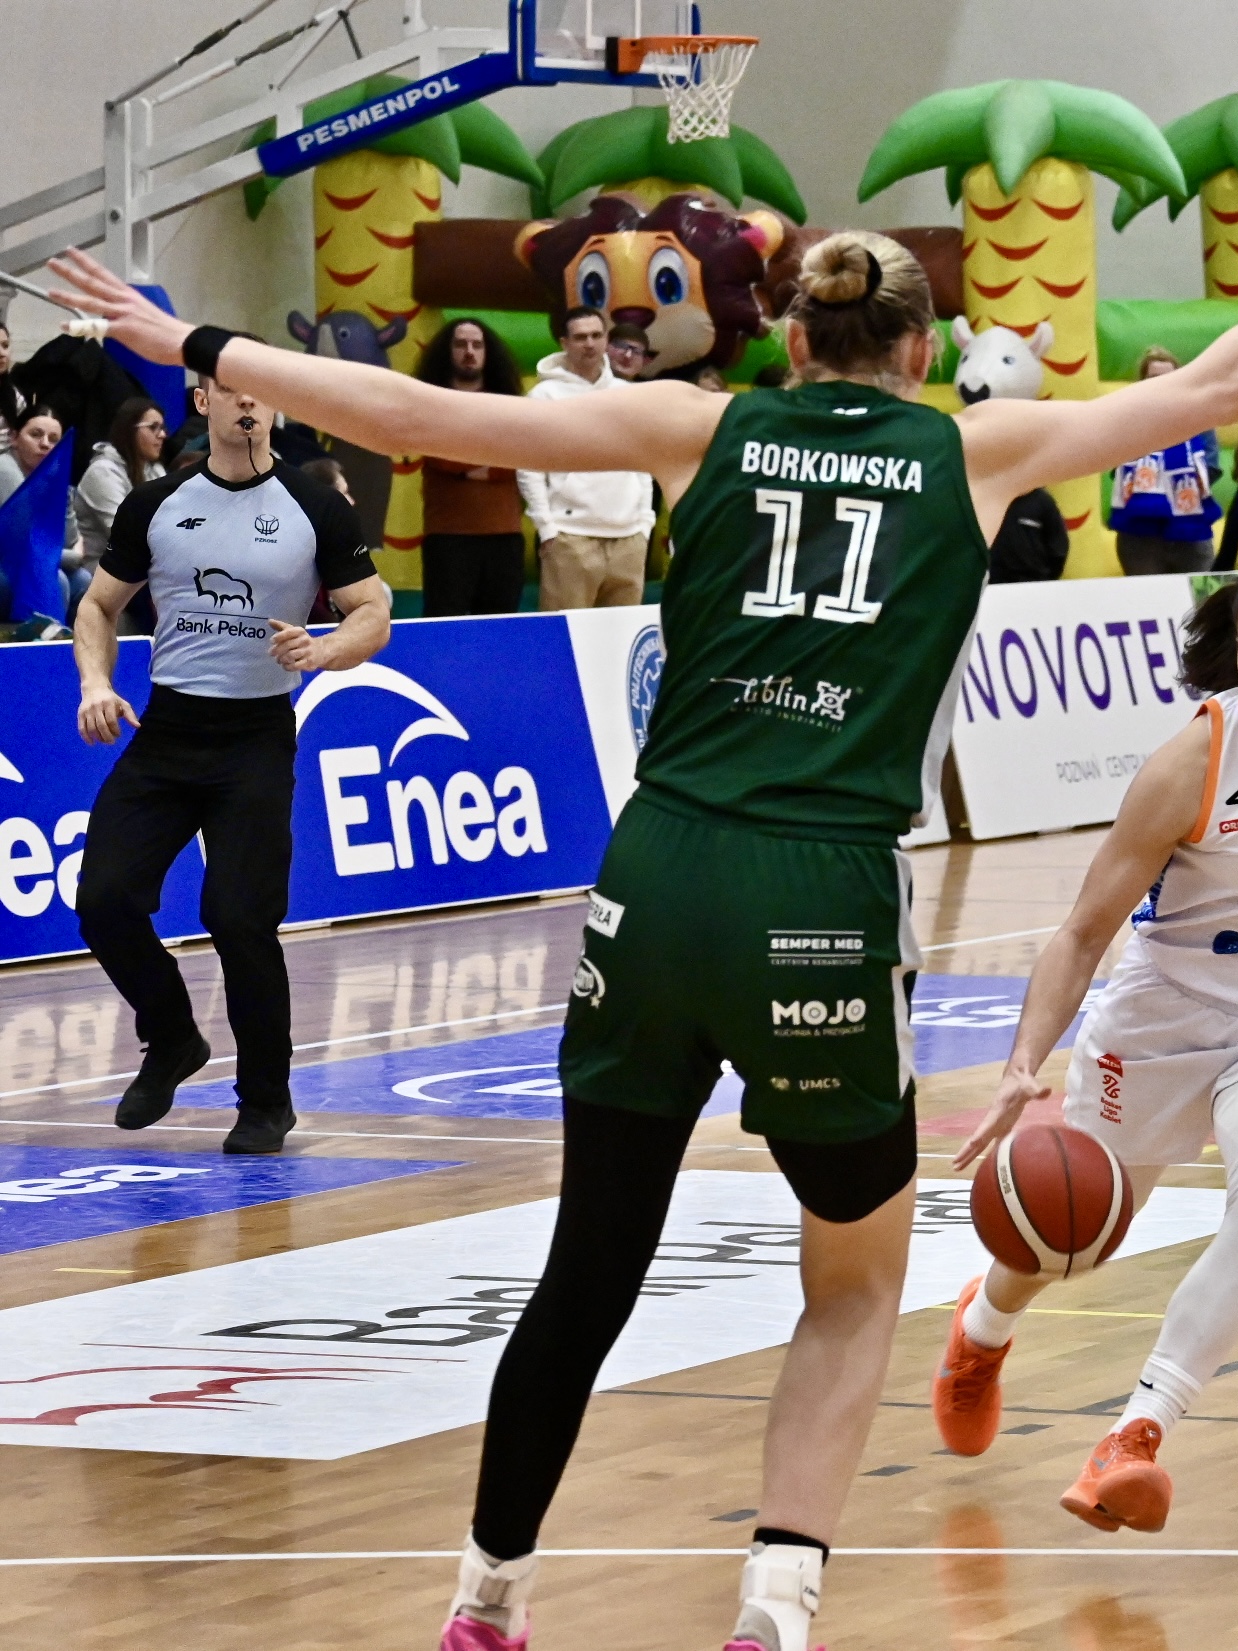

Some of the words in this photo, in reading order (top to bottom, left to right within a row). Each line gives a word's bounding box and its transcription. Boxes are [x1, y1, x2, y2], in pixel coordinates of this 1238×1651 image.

[296, 76, 460, 151] PESMENPOL
[741, 441, 922, 493] BORKOWSKA
[176, 517, 206, 530] 4F
[741, 488, 883, 624] 11
[176, 617, 213, 635] Bank
[217, 620, 266, 639] Pekao
[962, 618, 1203, 723] NOVOTEL
[319, 744, 548, 877] Enea
[770, 938, 831, 950] SEMPER
[834, 938, 864, 951] MED
[771, 998, 867, 1026] MOJO
[799, 1078, 841, 1091] UMCS
